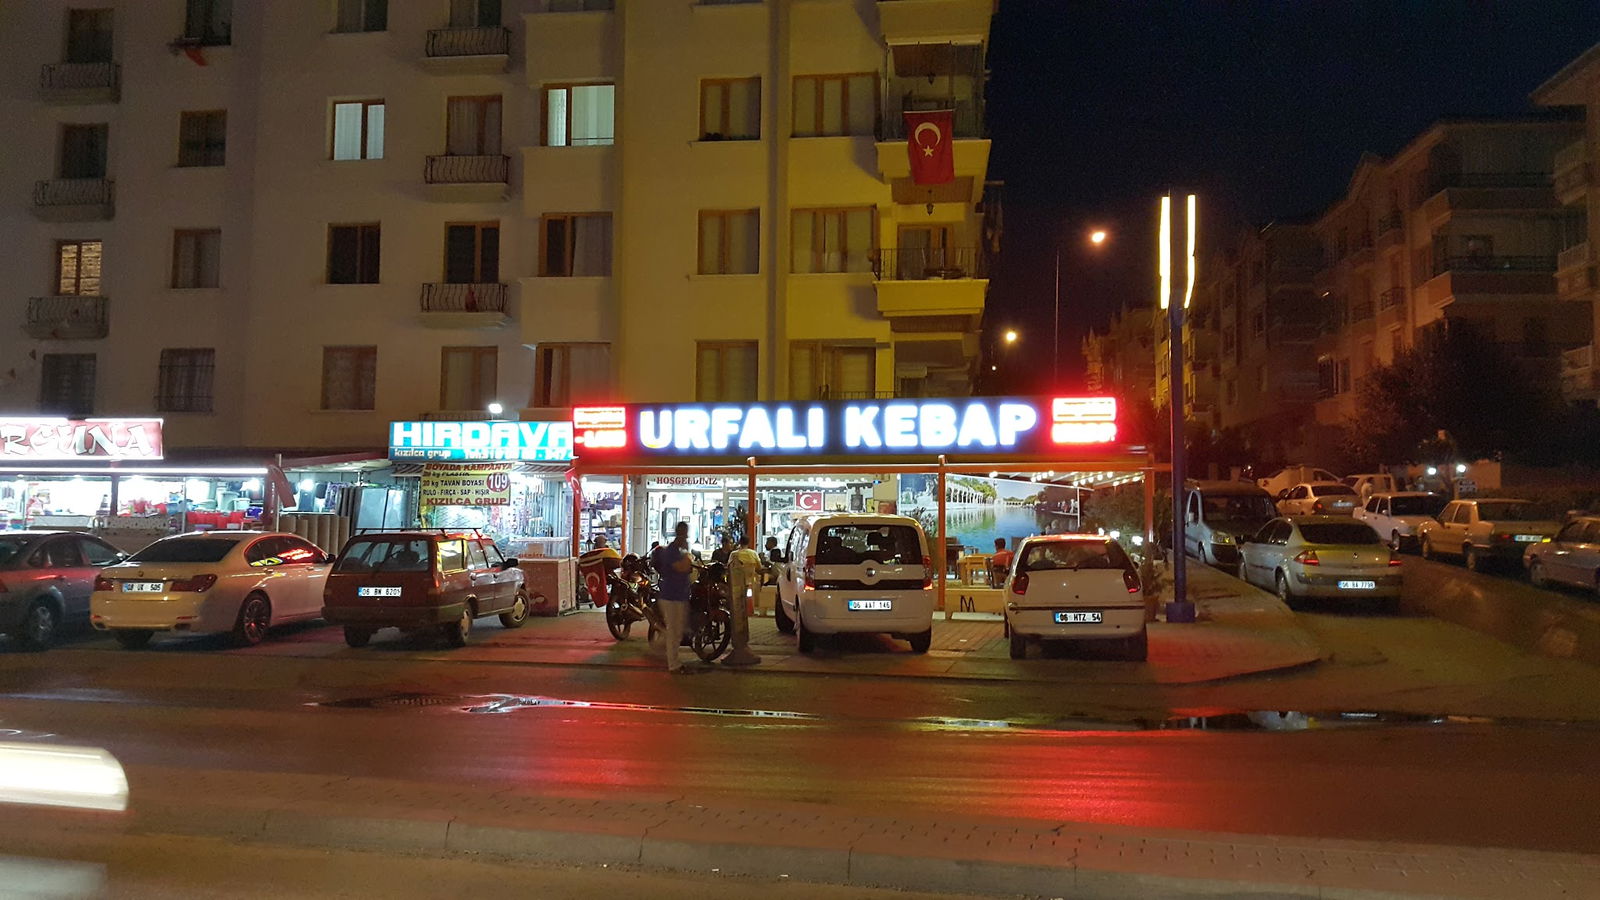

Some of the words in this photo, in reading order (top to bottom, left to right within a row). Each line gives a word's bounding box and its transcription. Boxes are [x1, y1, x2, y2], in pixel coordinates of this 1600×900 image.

[640, 406, 825, 450] URFALI
[844, 403, 1038, 448] KEBAP
[431, 480, 439, 488] kg
[489, 475, 508, 489] 109
[475, 497, 507, 505] GRUP
[1092, 613, 1101, 621] 54
